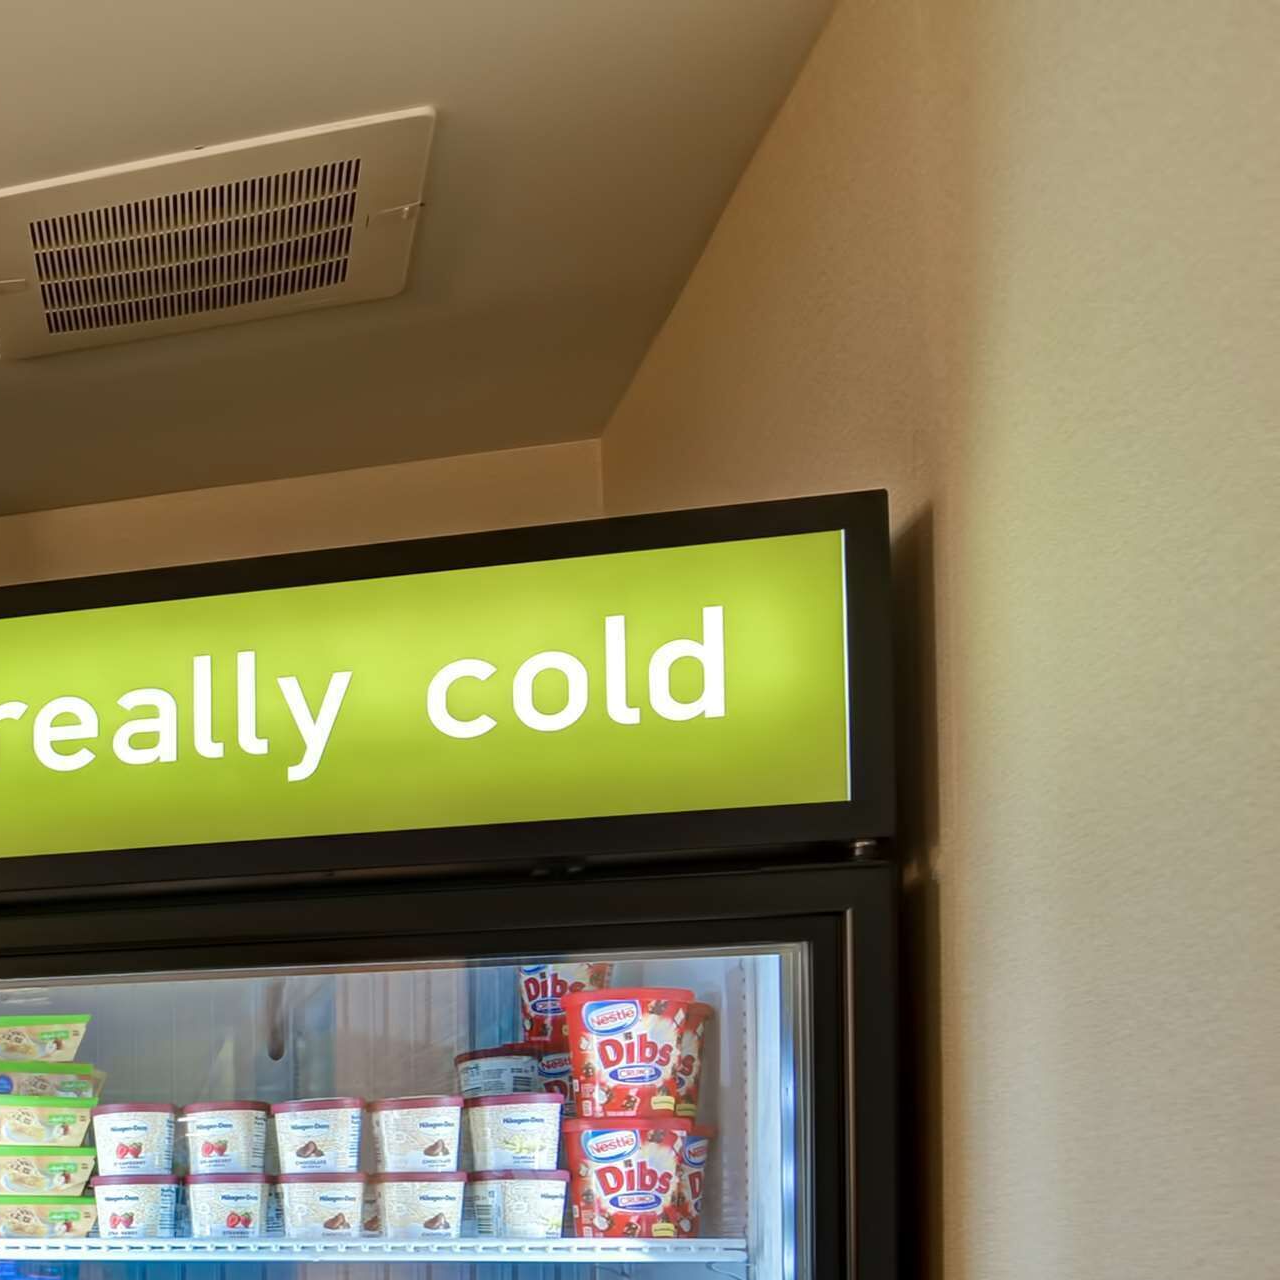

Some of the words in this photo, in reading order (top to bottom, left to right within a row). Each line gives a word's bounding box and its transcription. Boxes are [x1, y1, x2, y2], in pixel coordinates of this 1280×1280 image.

[426, 605, 726, 739] cold
[598, 1032, 674, 1069] Dibs
[595, 1160, 674, 1197] Dibs
